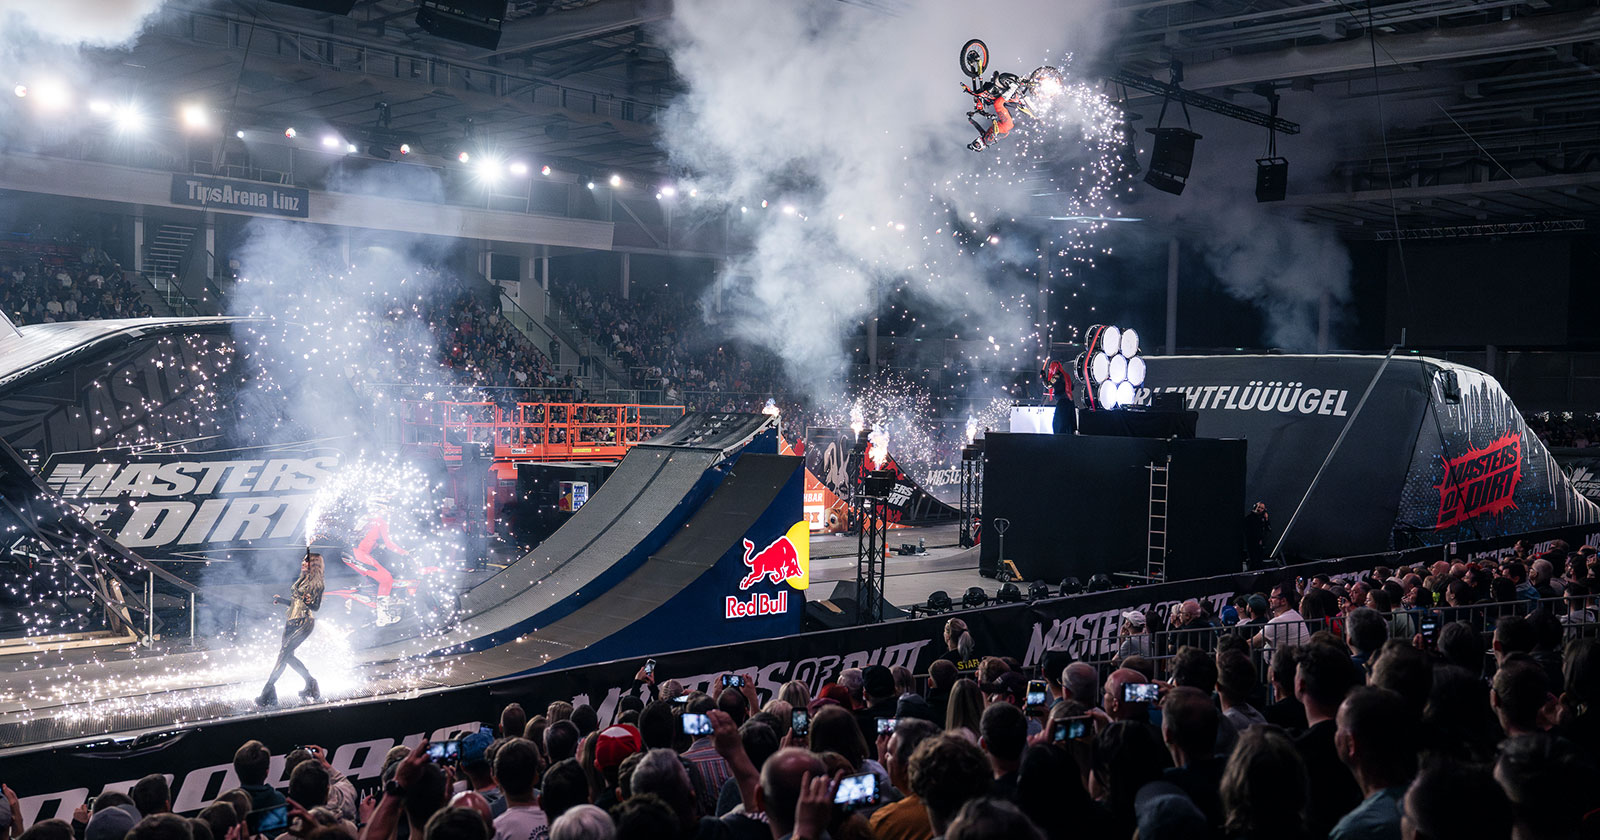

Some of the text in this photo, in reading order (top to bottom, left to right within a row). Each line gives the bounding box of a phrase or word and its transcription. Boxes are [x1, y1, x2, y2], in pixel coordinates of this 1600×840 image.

[186, 180, 300, 211] TipsArena Linz
[46, 456, 339, 498] MASTERS
[1444, 441, 1518, 490] MASTERS
[1464, 465, 1518, 514] DIRT
[726, 590, 788, 618] Red Bull
